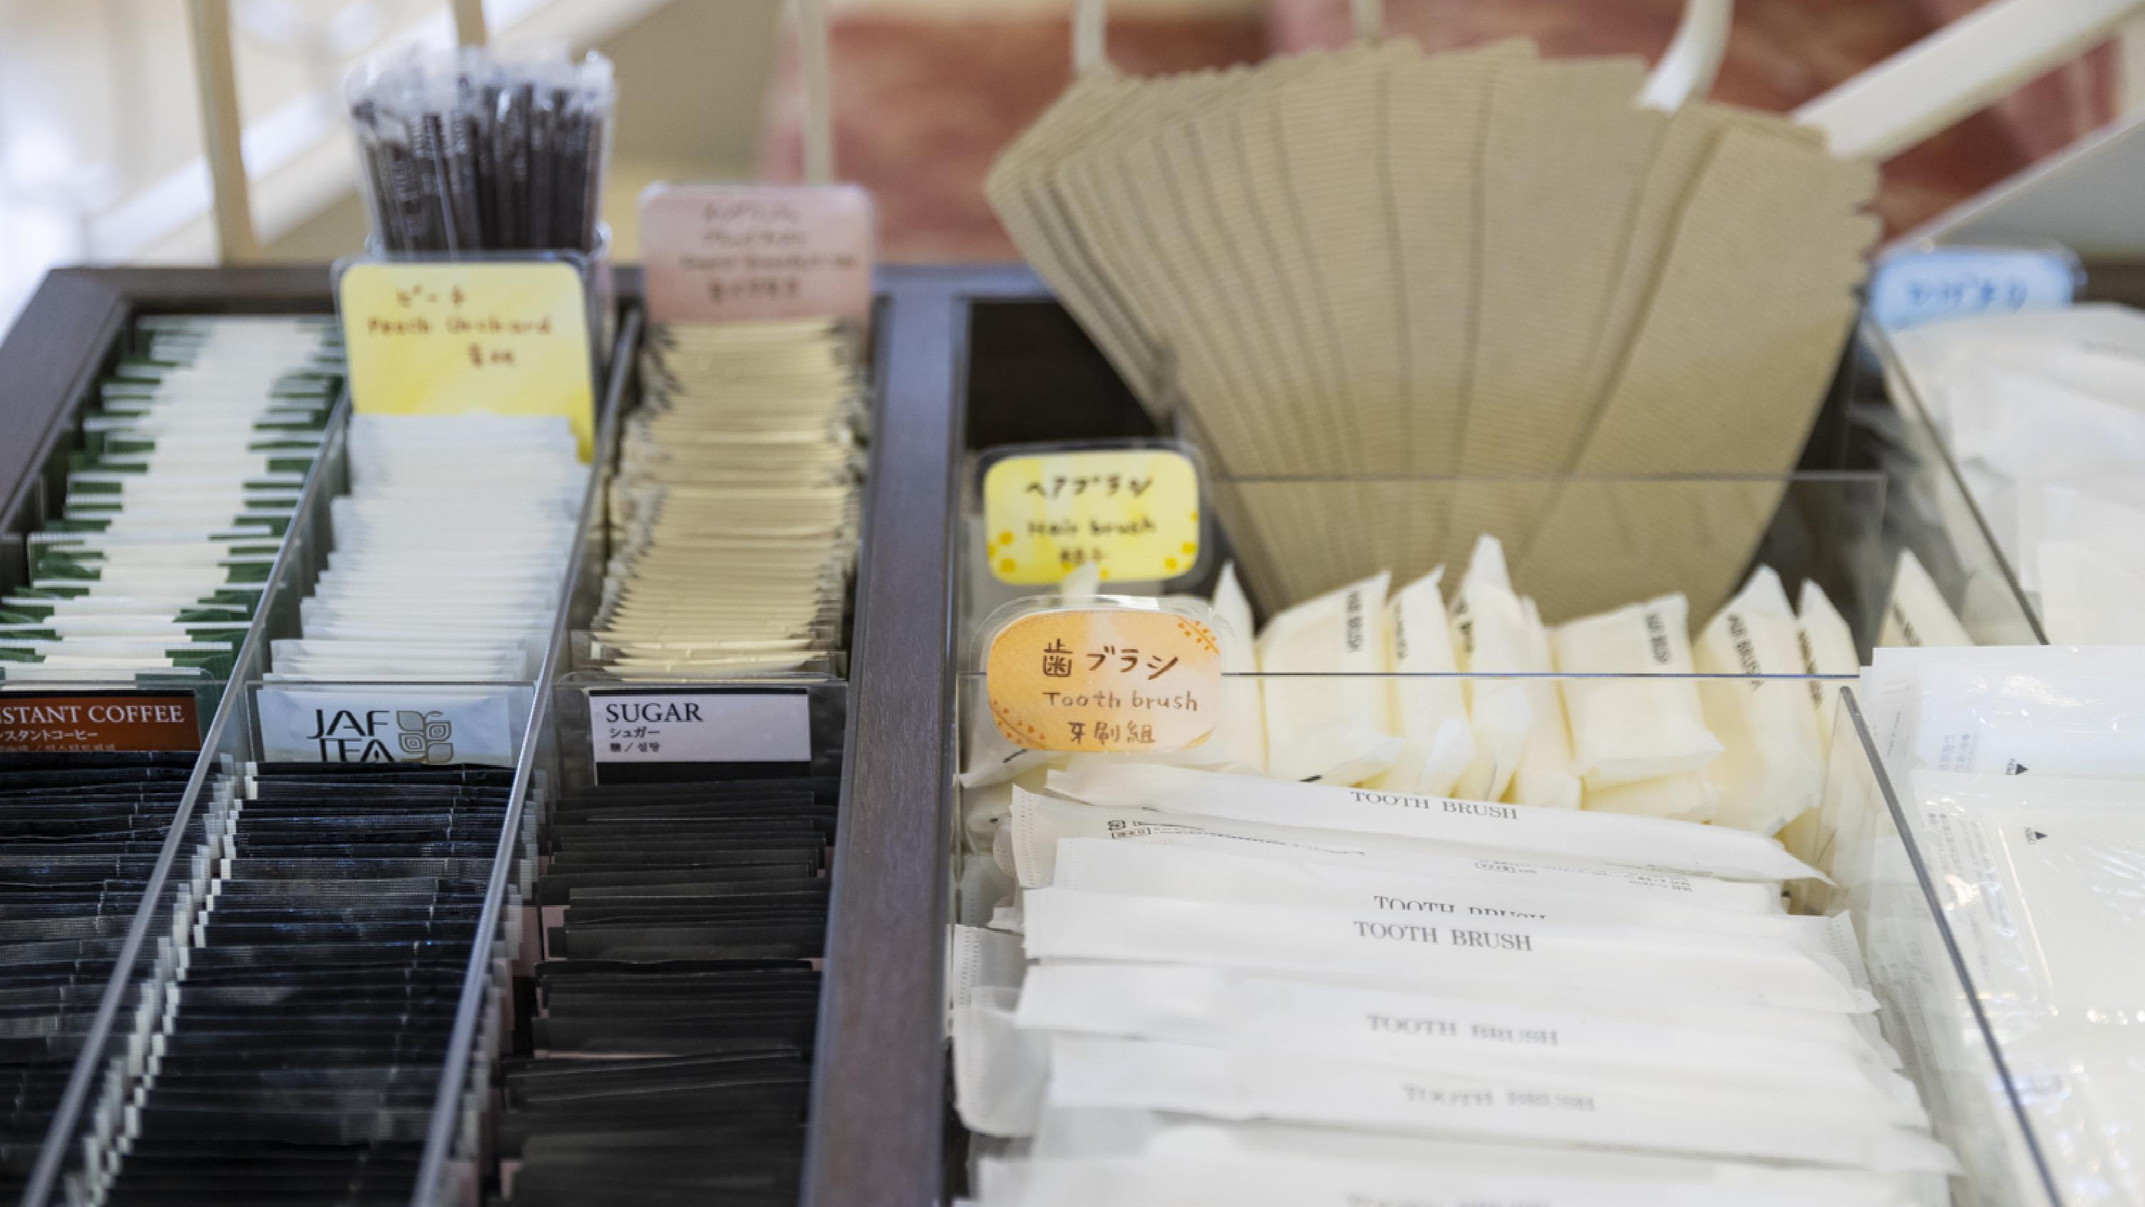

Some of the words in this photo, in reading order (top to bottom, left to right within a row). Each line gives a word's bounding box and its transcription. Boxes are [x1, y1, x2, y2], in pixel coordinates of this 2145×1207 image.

[1042, 639, 1179, 680] 歯ブラシ
[0, 705, 81, 724] STANT
[88, 705, 185, 723] COFFEE
[606, 703, 703, 722] SUGAR
[1042, 690, 1121, 708] Tooth
[1131, 690, 1199, 712] brush
[307, 709, 389, 739] JAF
[610, 726, 661, 739] シュガー
[1351, 791, 1430, 809] TOOTH
[1443, 801, 1519, 820] BRUSH
[1354, 921, 1438, 944] TOOTH
[1451, 928, 1532, 951] BRUSH
[1367, 1014, 1457, 1037] TOOTH
[1471, 1024, 1558, 1045] BRUSH
